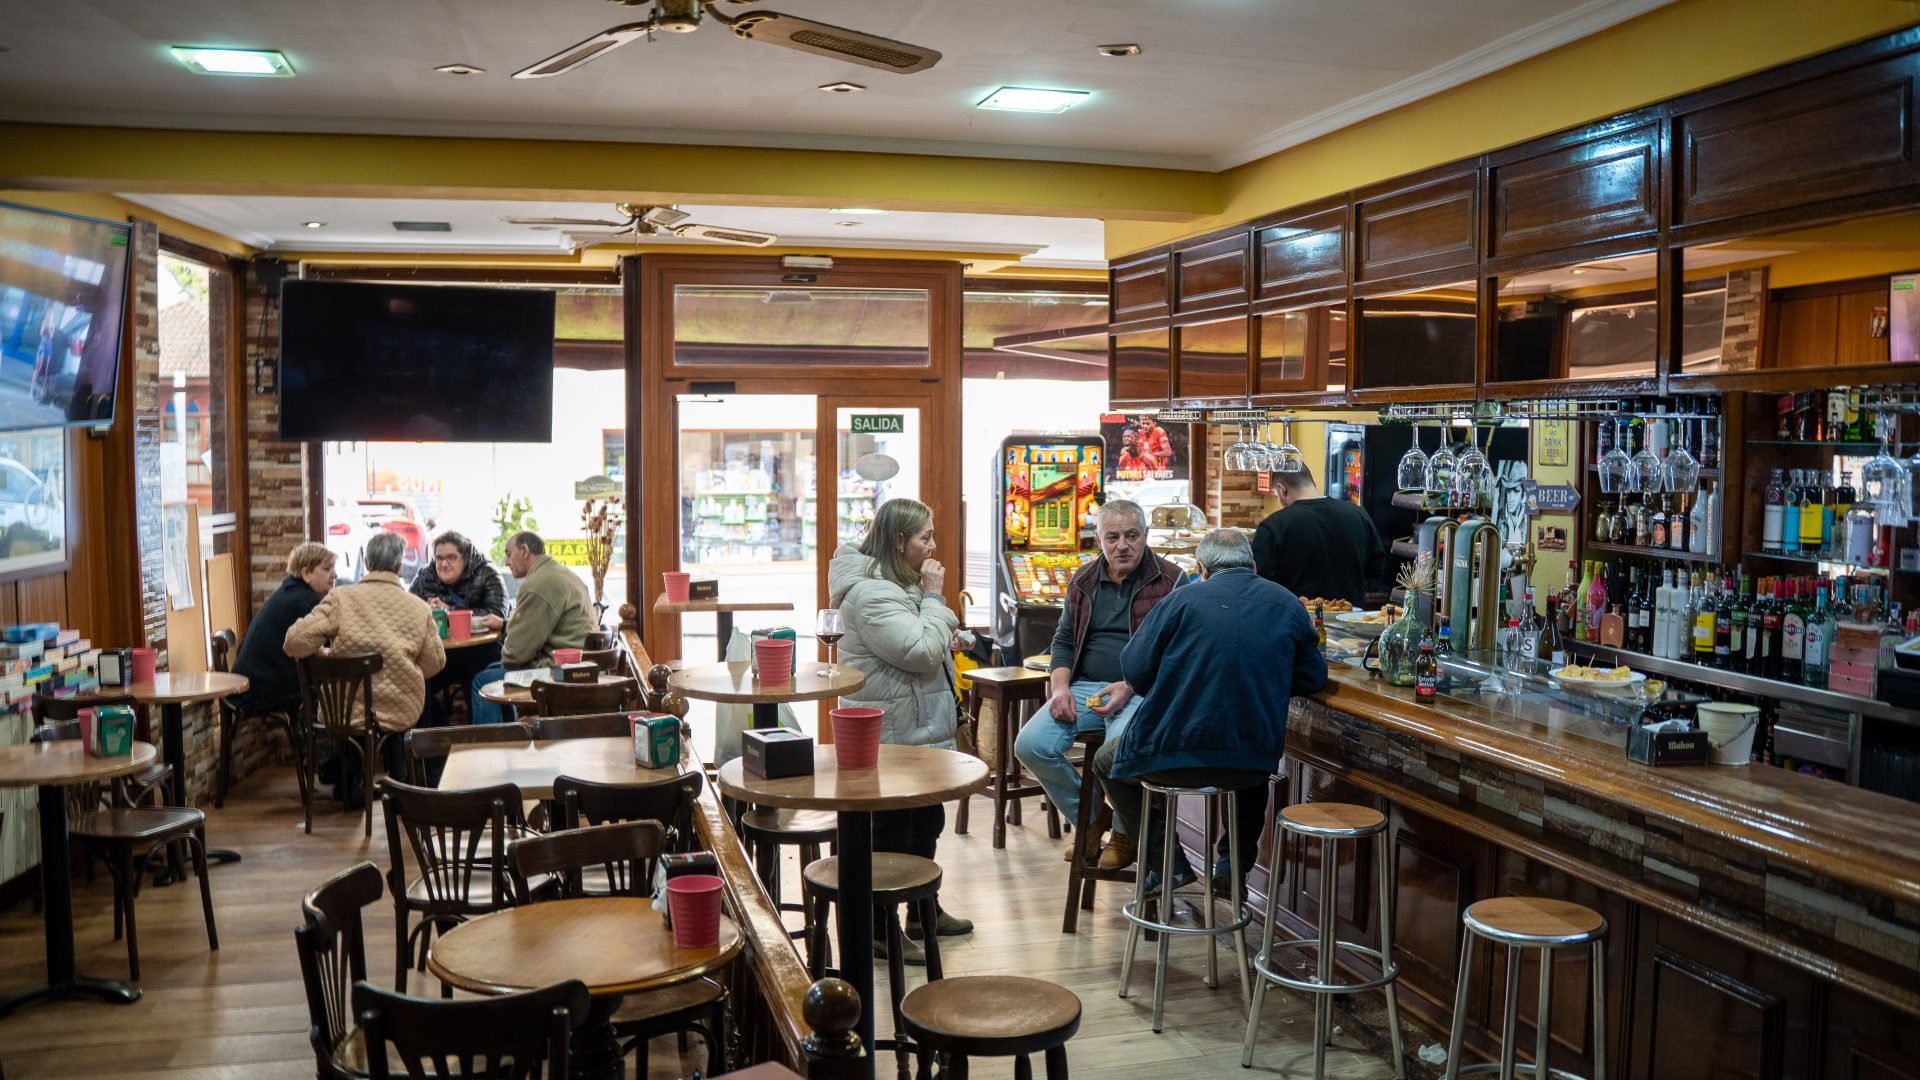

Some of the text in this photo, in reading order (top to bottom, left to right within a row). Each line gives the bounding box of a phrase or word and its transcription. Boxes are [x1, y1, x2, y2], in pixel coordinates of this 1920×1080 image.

[854, 418, 899, 430] SALIDA
[1538, 489, 1568, 503] BEER
[1525, 639, 1532, 651] S
